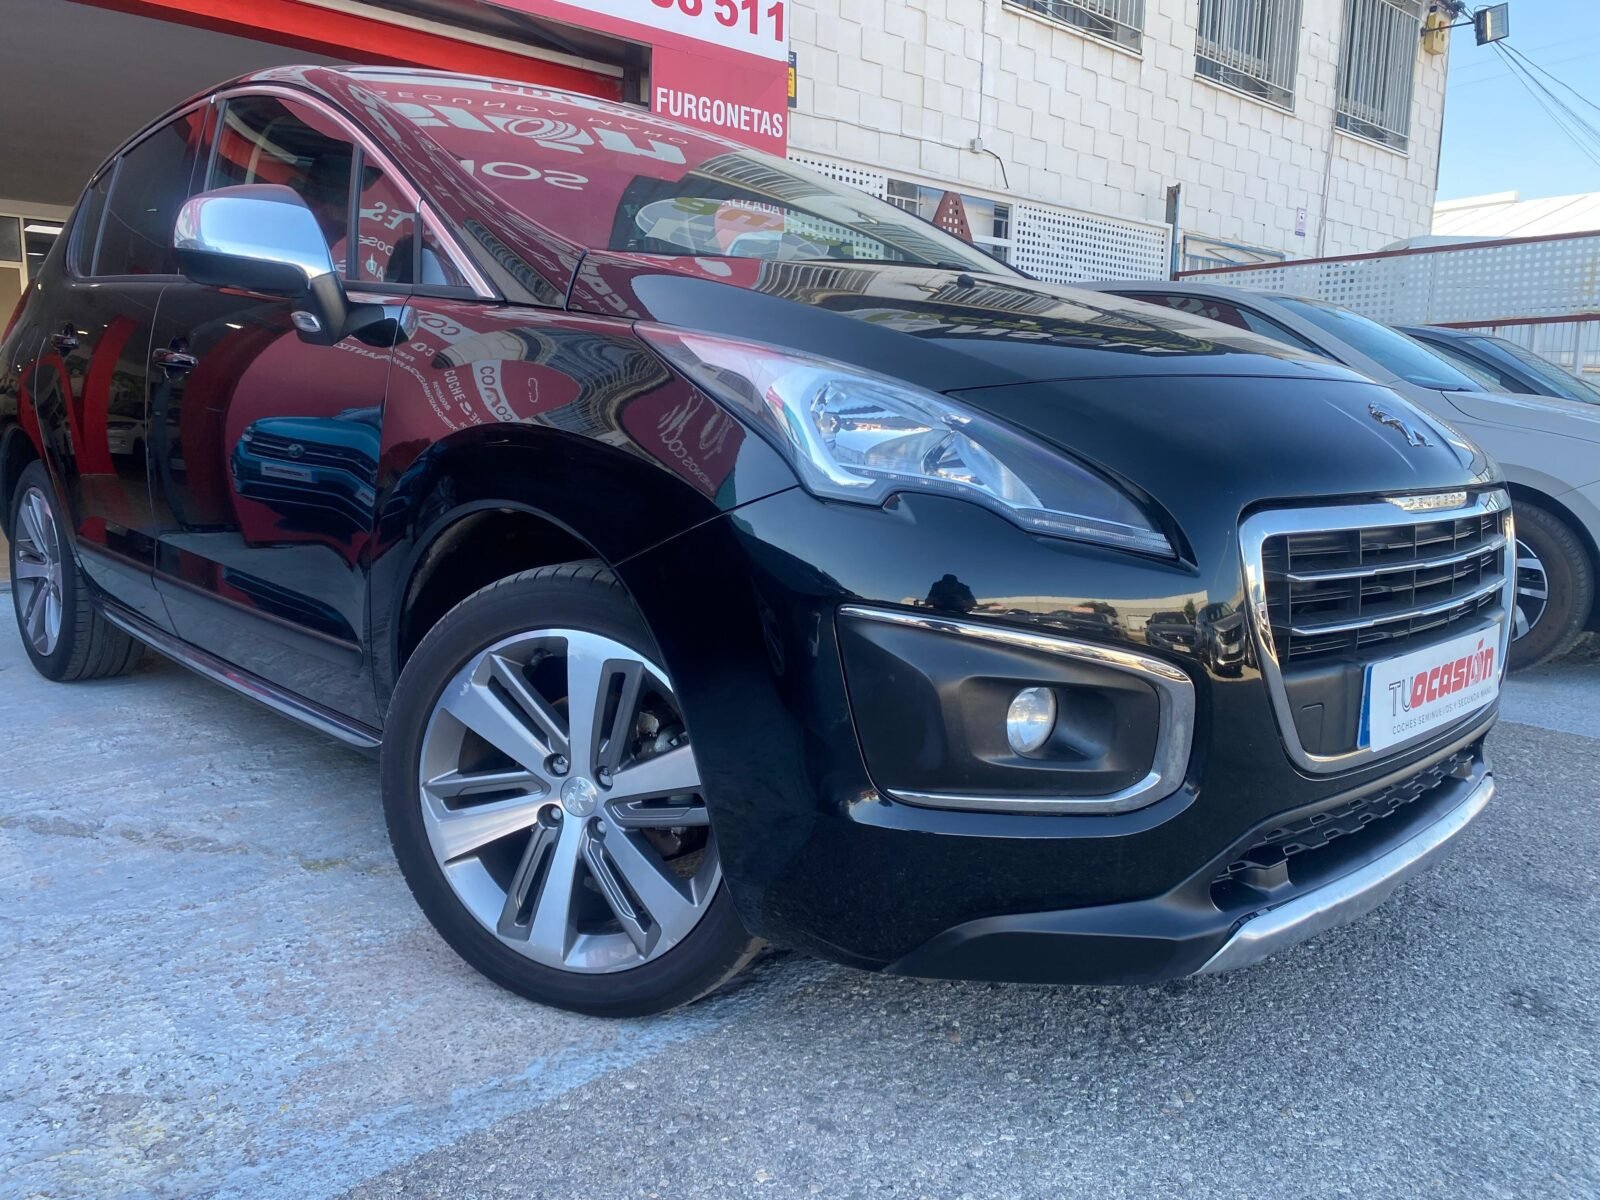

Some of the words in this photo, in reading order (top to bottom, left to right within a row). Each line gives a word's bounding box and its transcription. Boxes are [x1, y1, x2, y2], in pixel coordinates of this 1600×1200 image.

[714, 0, 784, 42] 511
[656, 87, 783, 138] FURGONETAS
[1392, 718, 1417, 735] COCHES
